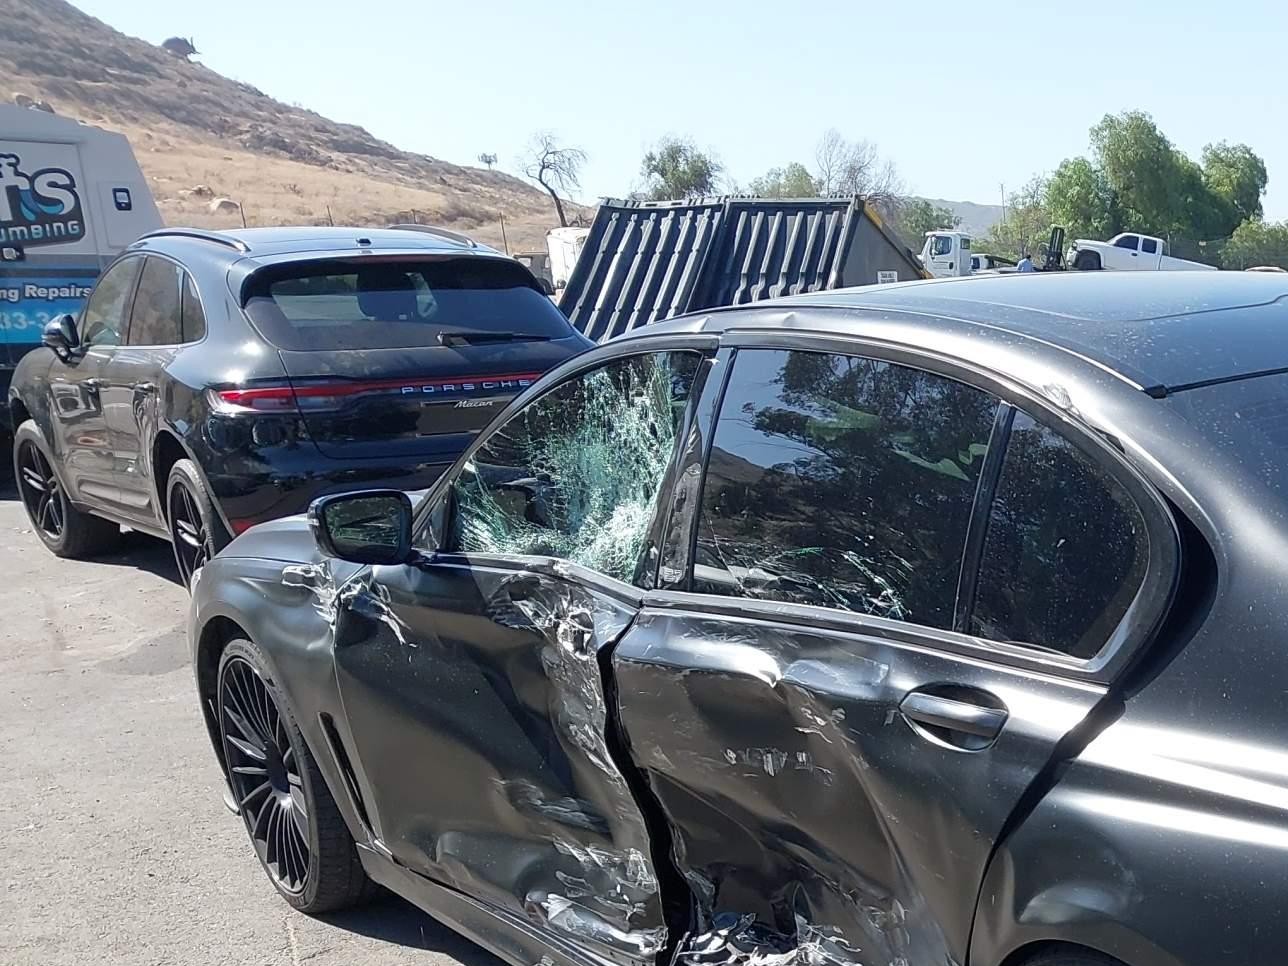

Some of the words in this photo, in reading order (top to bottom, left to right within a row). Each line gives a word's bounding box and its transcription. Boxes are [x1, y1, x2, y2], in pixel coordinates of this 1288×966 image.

[24, 284, 92, 300] Repairs
[401, 379, 530, 395] PORSCHE
[453, 400, 494, 409] Macan
